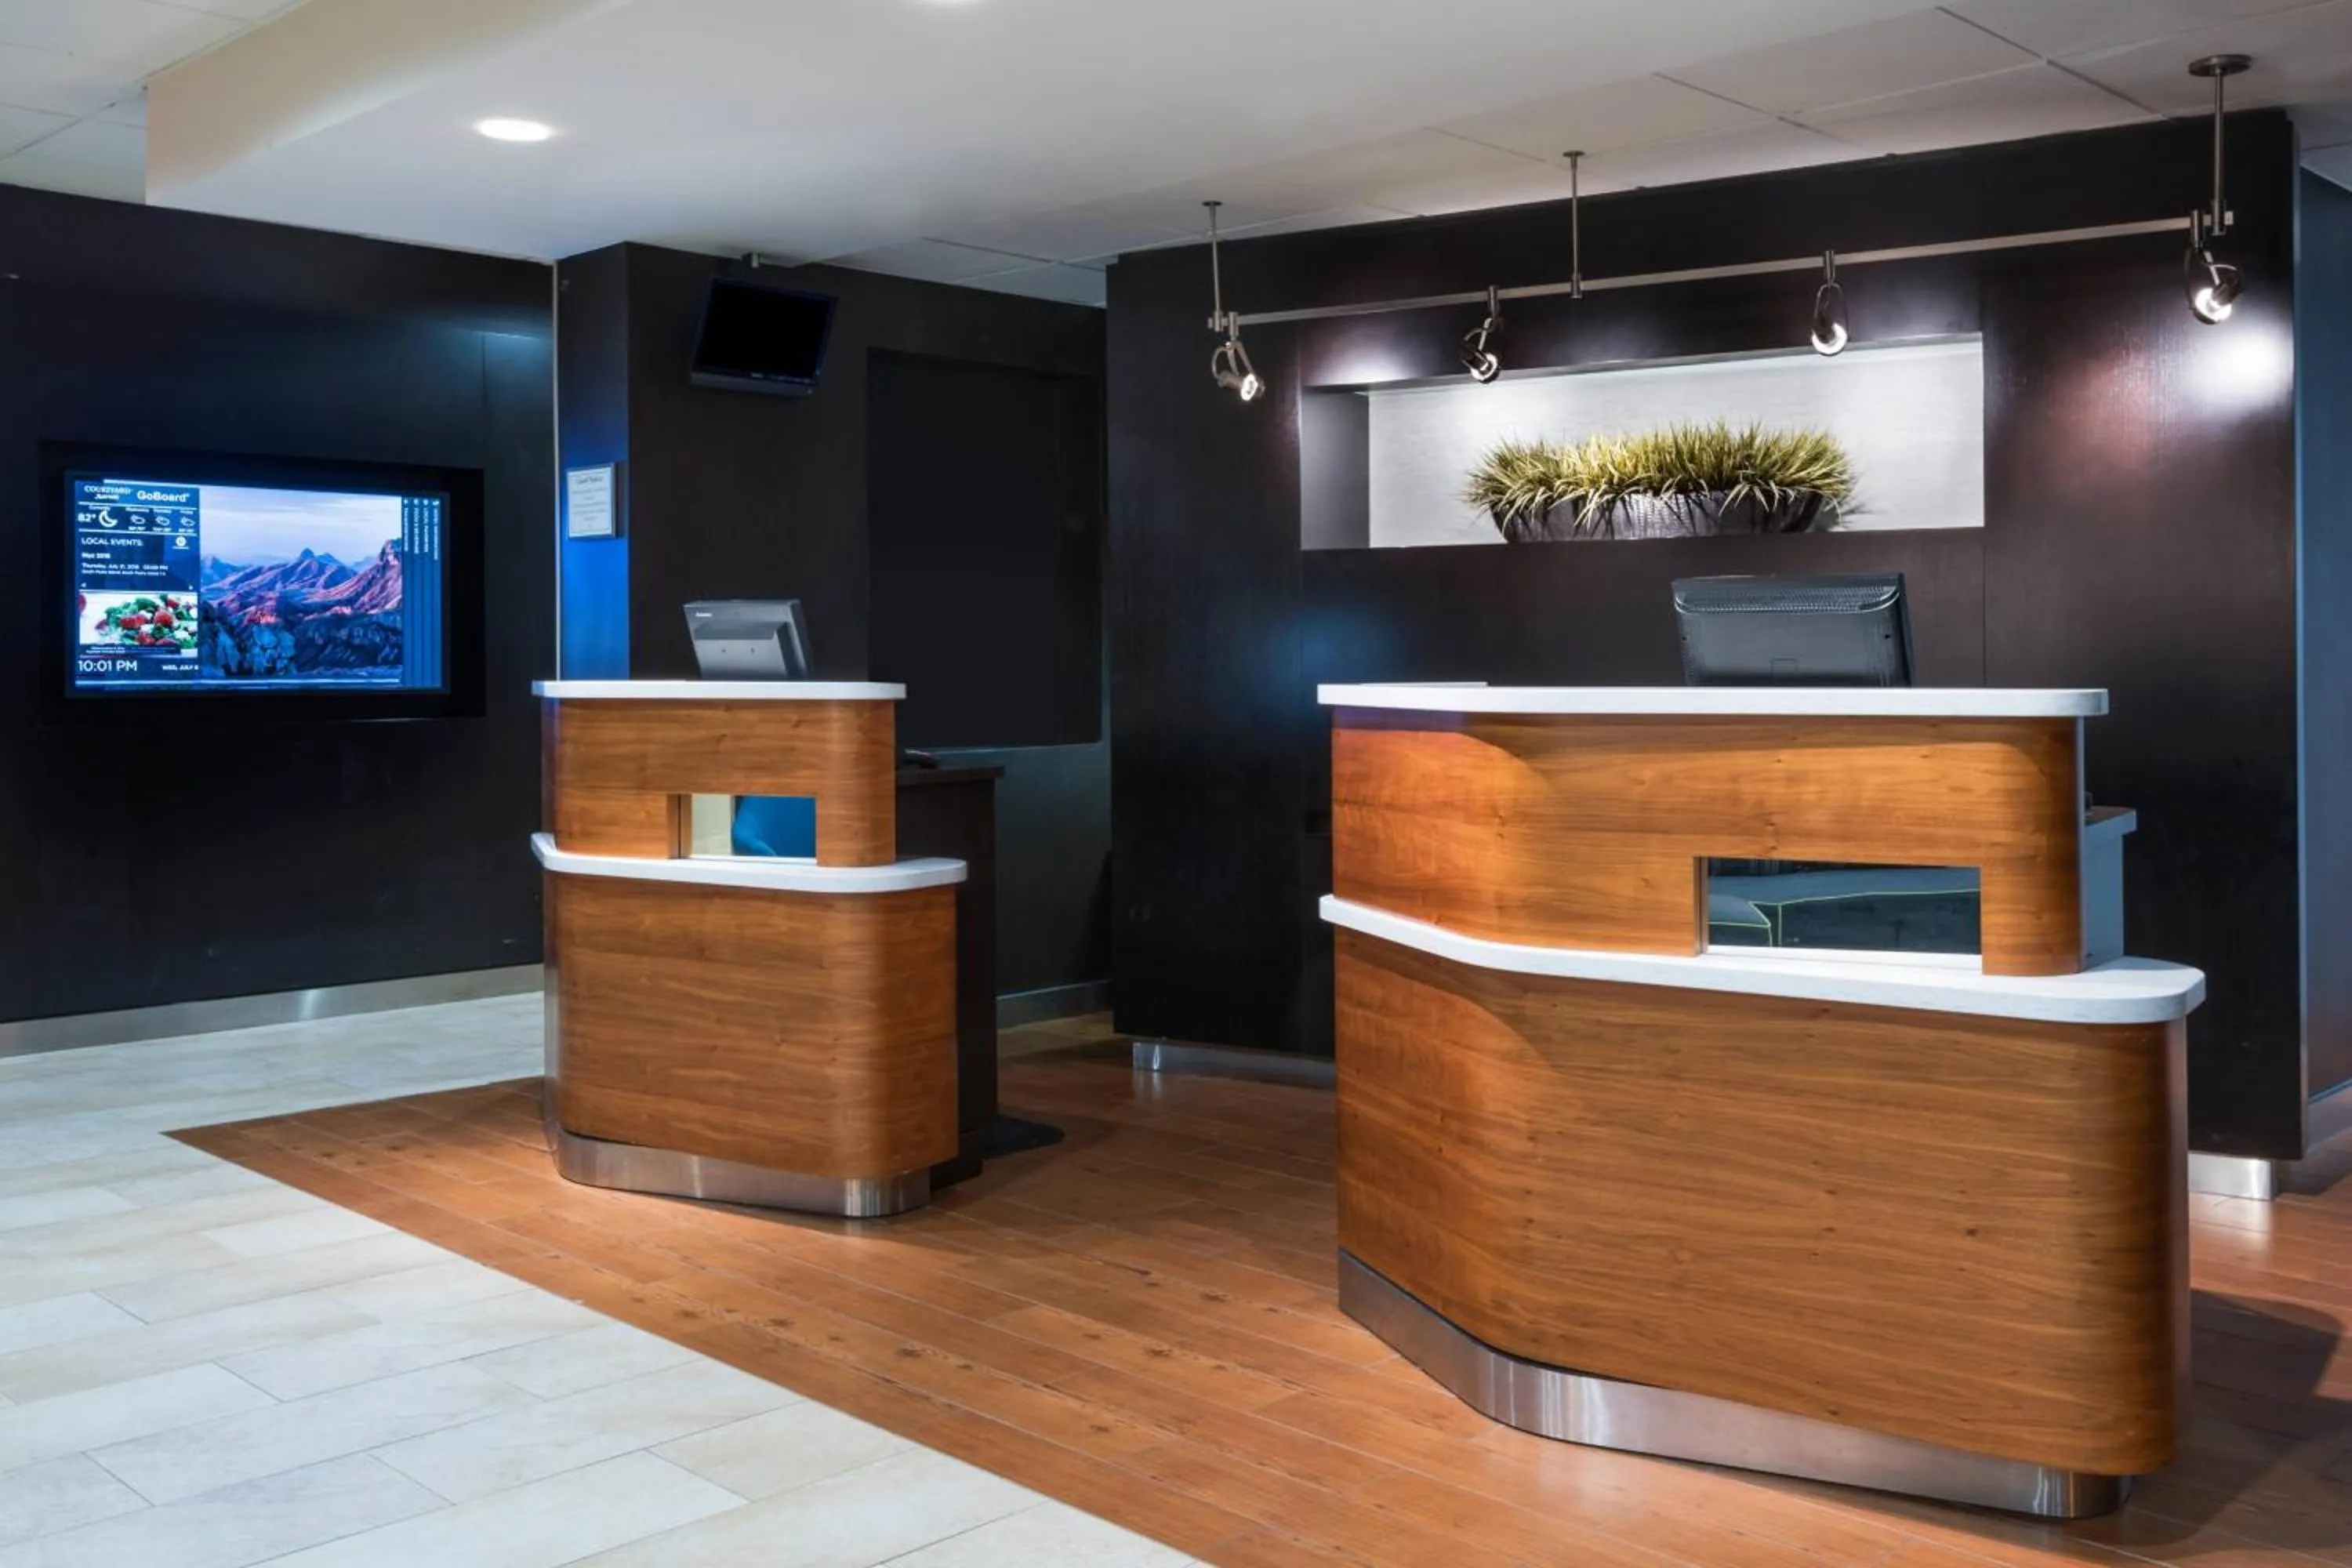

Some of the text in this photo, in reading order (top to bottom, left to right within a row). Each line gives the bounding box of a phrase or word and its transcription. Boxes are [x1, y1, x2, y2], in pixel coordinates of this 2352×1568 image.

[81, 537, 109, 546] LOCAL
[78, 659, 137, 672] 10:01 PM
